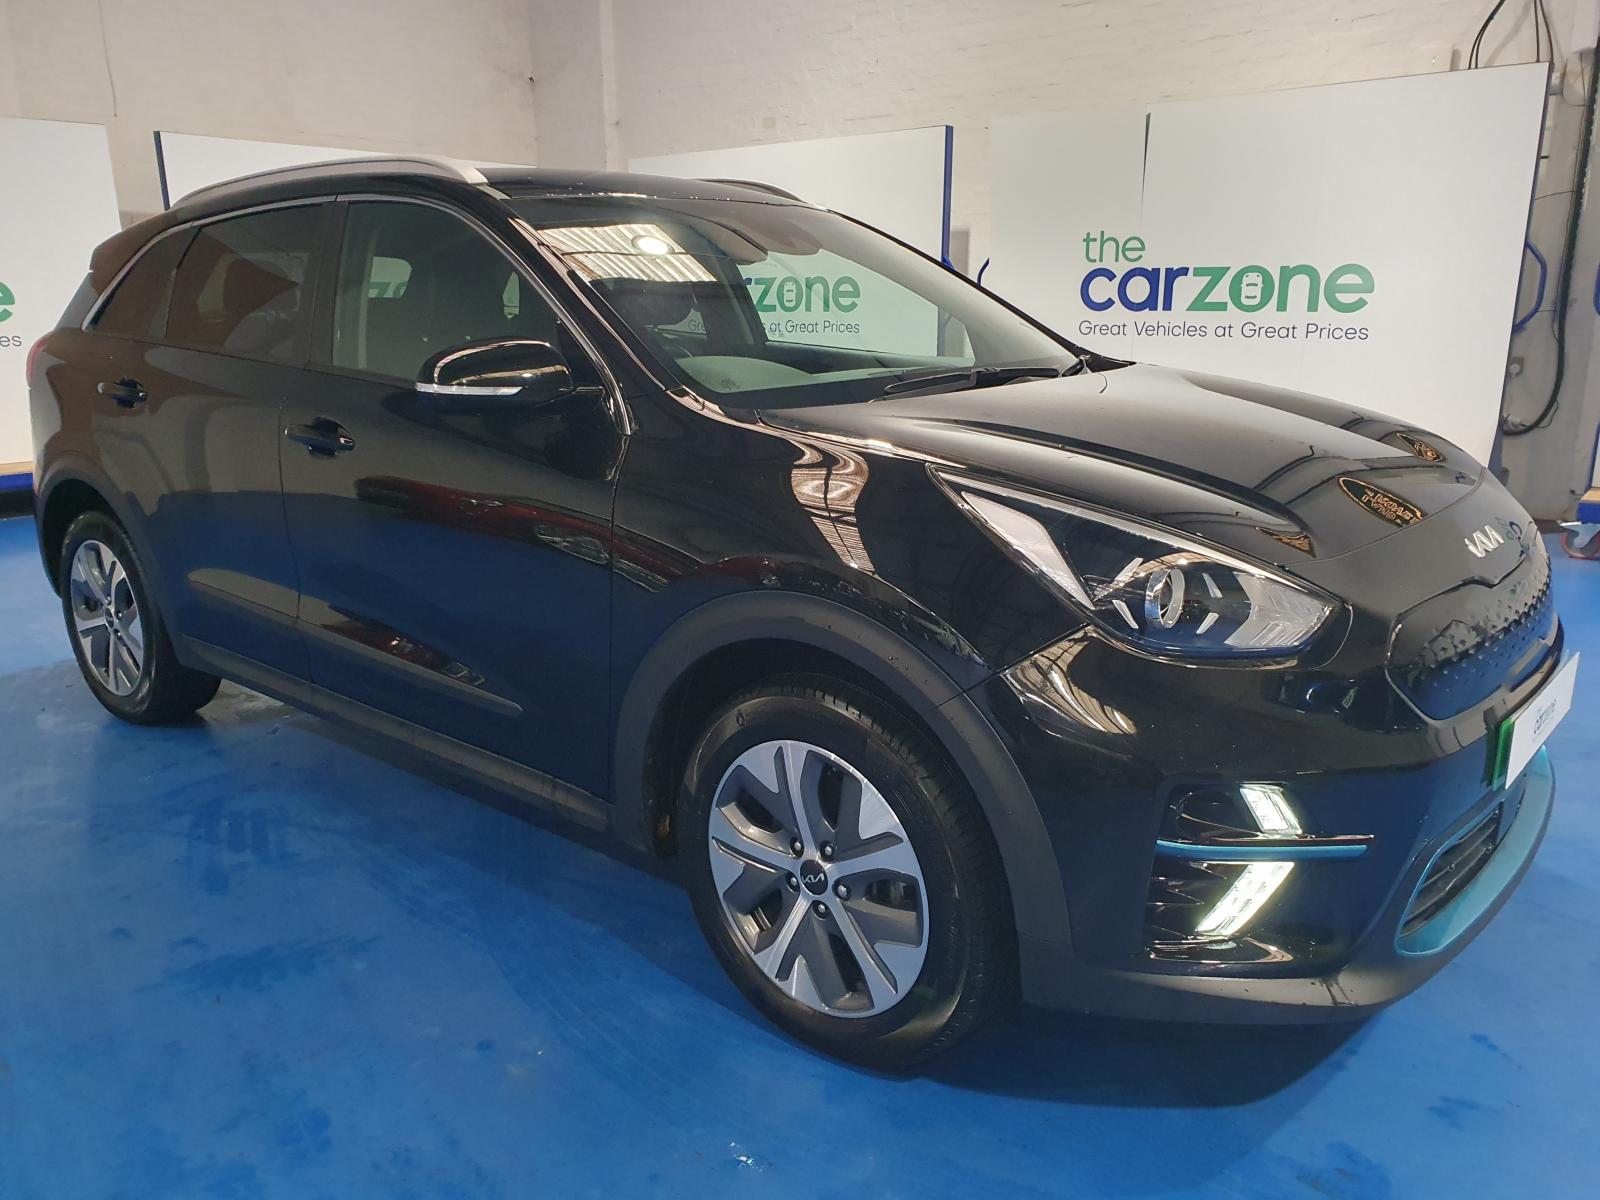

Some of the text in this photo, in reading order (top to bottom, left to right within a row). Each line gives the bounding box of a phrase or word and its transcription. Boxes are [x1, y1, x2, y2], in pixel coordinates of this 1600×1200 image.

[1083, 230, 1146, 263] the
[1080, 263, 1375, 314] carzone
[785, 319, 819, 334] Great
[823, 320, 860, 334] Prices
[1078, 319, 1370, 340] Great Vehicles at Great Prices
[801, 872, 825, 884] KIA
